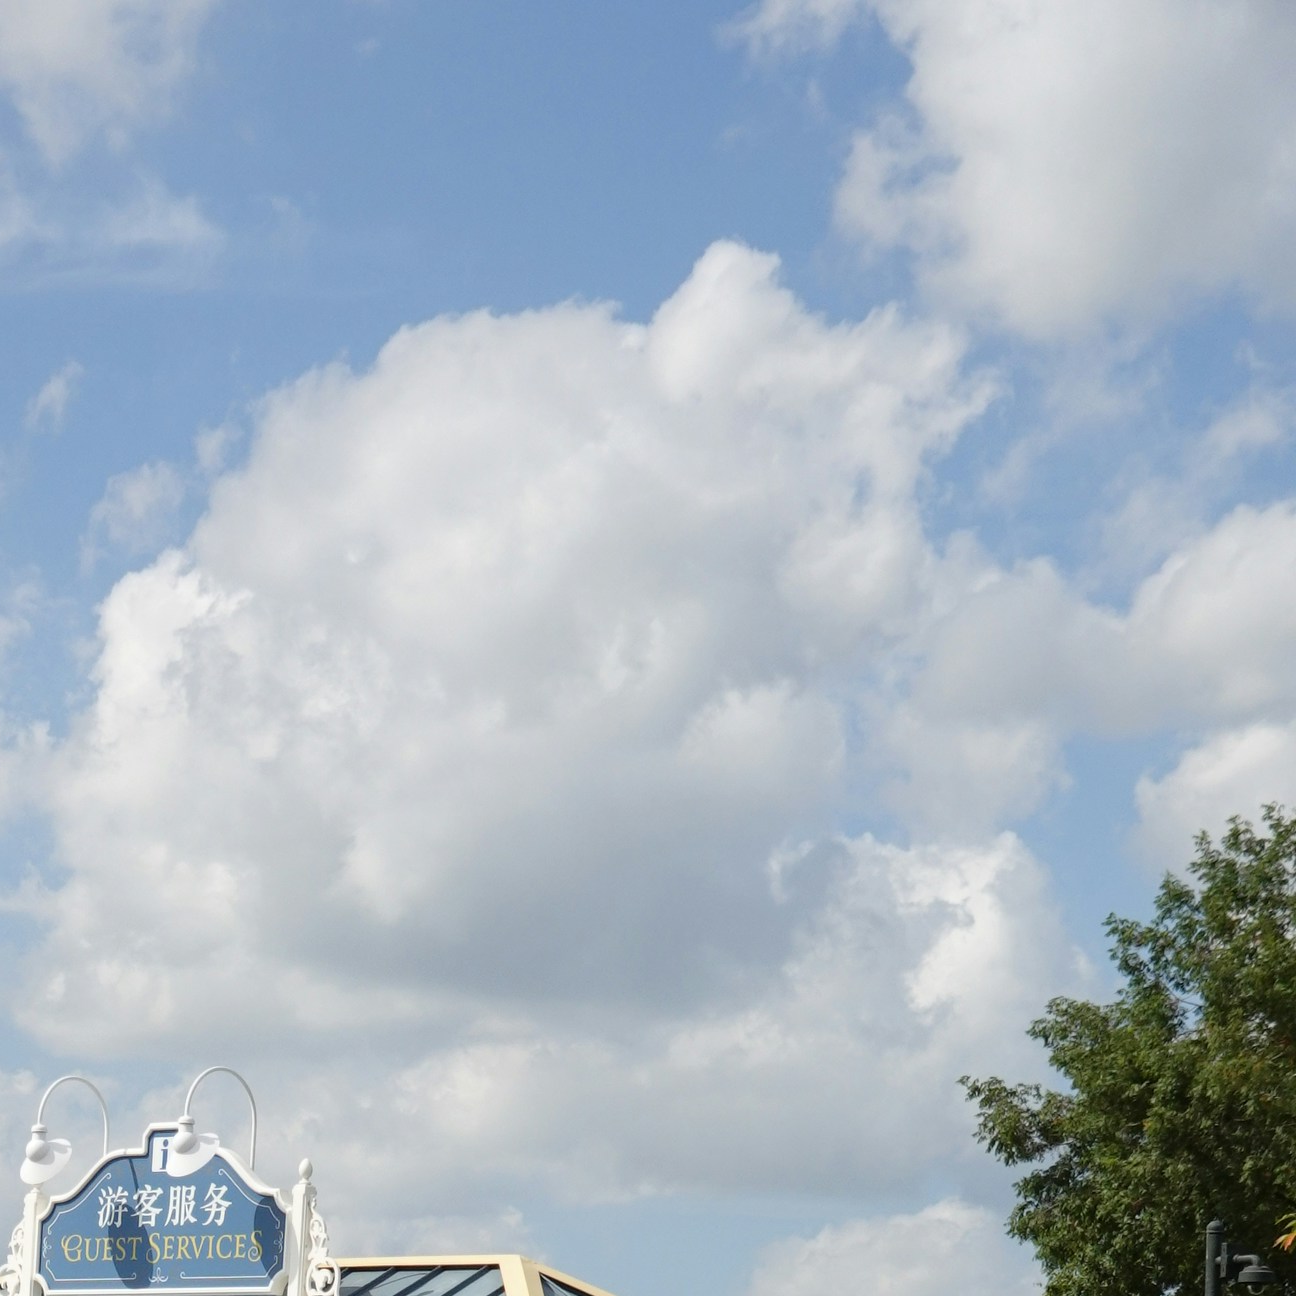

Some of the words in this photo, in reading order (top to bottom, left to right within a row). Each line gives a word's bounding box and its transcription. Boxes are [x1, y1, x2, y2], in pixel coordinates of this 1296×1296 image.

[96, 1182, 232, 1229] 游客服务
[60, 1233, 142, 1263] GUEST
[145, 1230, 264, 1264] SERVICES
